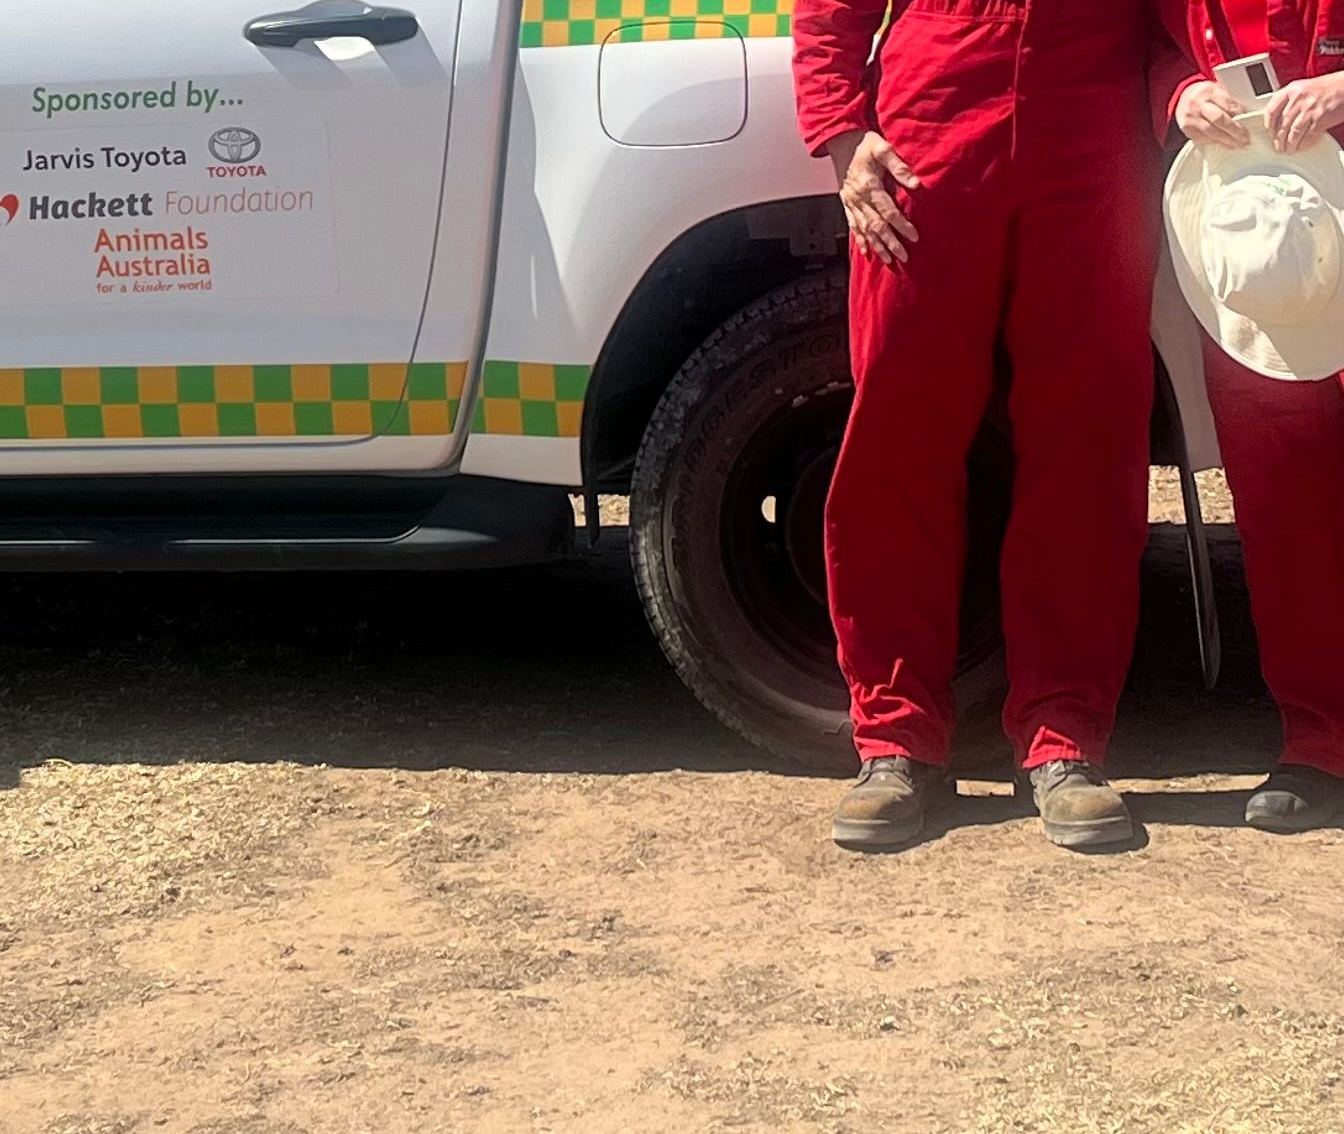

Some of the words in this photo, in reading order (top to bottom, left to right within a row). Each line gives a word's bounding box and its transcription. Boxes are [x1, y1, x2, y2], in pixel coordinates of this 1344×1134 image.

[32, 82, 177, 119] Sponsored
[186, 80, 244, 113] by...
[23, 147, 95, 171] Jarvis
[101, 146, 187, 172] Toyota
[207, 164, 267, 178] TOYOTA
[29, 192, 154, 220] Hackett
[165, 186, 315, 215] Foundation
[94, 225, 209, 253] Animals
[96, 253, 211, 278] Australia
[96, 282, 115, 294] for
[119, 284, 127, 293] a
[132, 280, 174, 293] kinder
[177, 278, 212, 291] world
